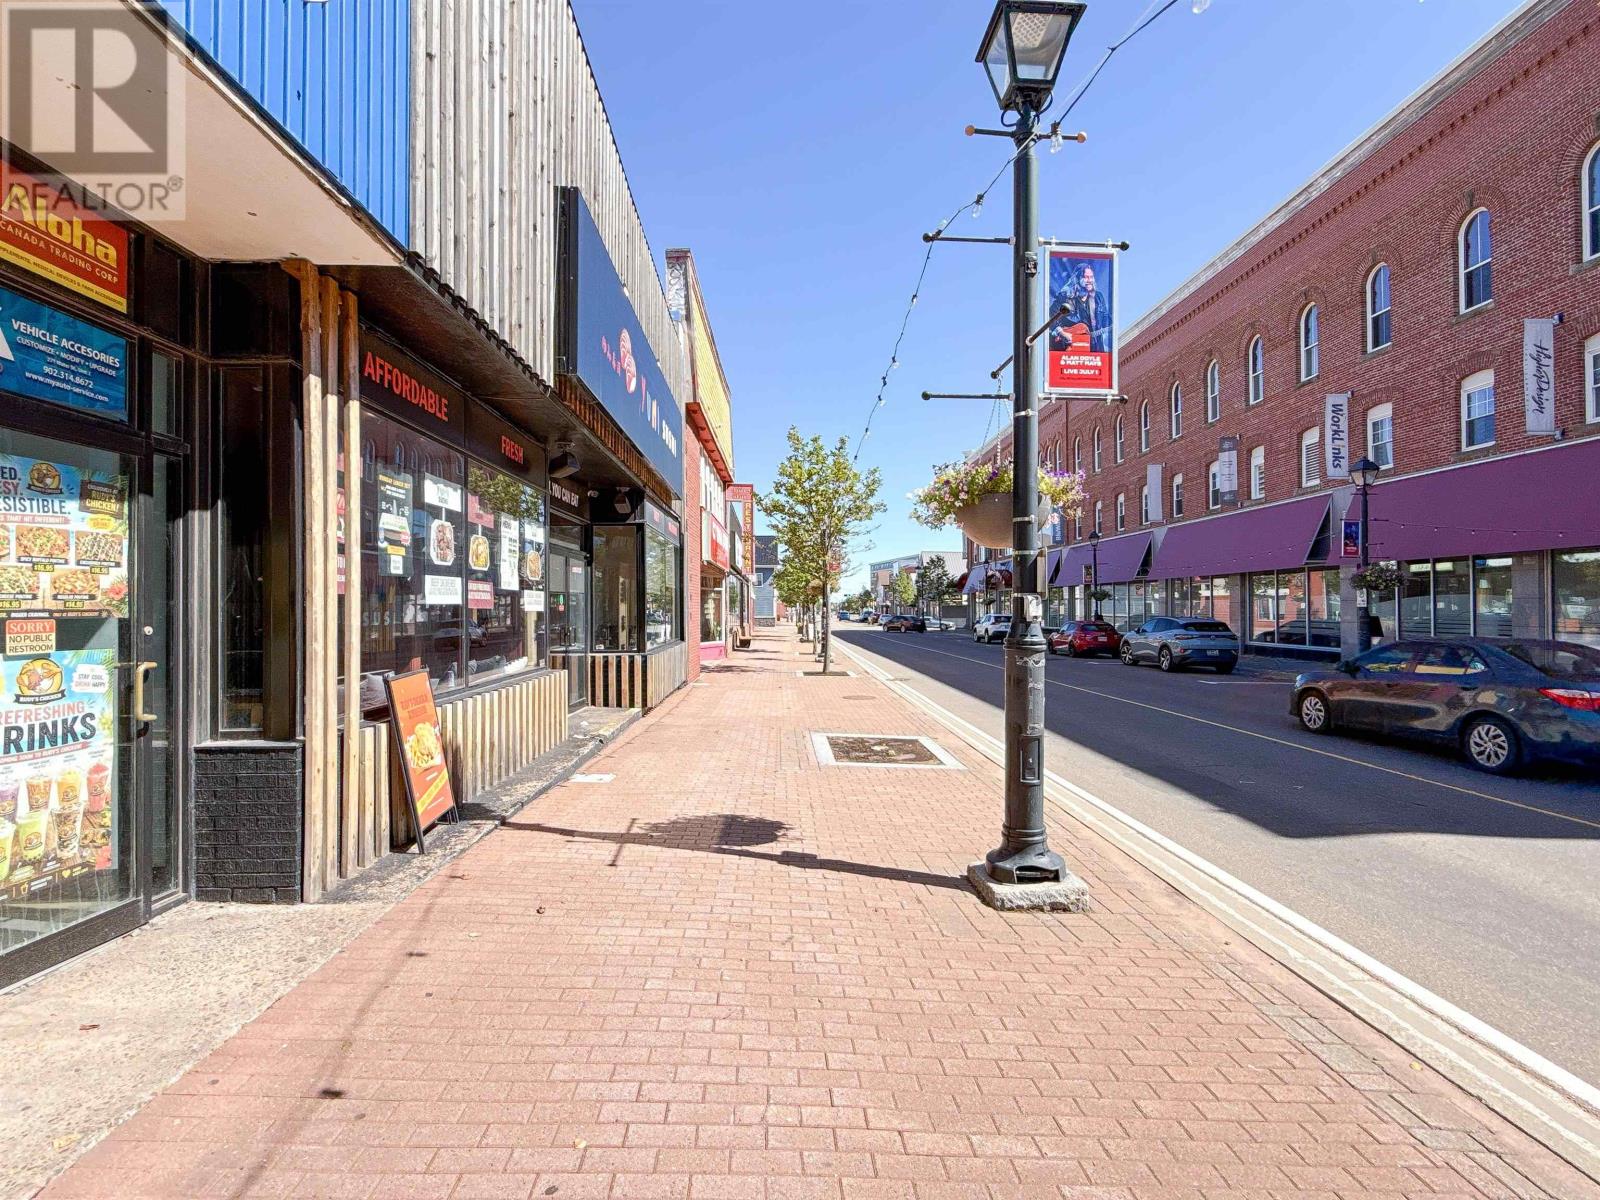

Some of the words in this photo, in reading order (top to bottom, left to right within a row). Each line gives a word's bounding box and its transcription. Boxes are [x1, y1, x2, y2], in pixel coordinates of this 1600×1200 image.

[1, 183, 117, 268] Aloha
[0, 221, 46, 249] CANADA
[49, 244, 92, 272] TRADING
[95, 268, 119, 283] CORP
[11, 318, 59, 345] VEHICLE
[60, 338, 120, 368] ACCESORIES
[16, 336, 56, 355] CUSTOMIZE
[60, 351, 85, 366] MODIFY
[89, 361, 117, 377] UPGRADE
[25, 371, 109, 402] www.myauto-service.com
[43, 365, 94, 389] 902.314.8672
[364, 351, 448, 422] AFFORDABLE
[502, 435, 524, 464] FRESH
[662, 419, 677, 458] SUSHI
[1330, 403, 1346, 469] WorkLinks
[86, 499, 119, 512] CHICKEN!
[551, 482, 562, 499] YOU
[562, 488, 571, 504] CAN
[571, 492, 579, 507] EAT
[9, 636, 23, 644] NO
[24, 634, 53, 643] PUBLIC
[10, 622, 53, 634] SORRY
[9, 644, 54, 653] RESTROOM
[3, 712, 97, 755] RINKS
